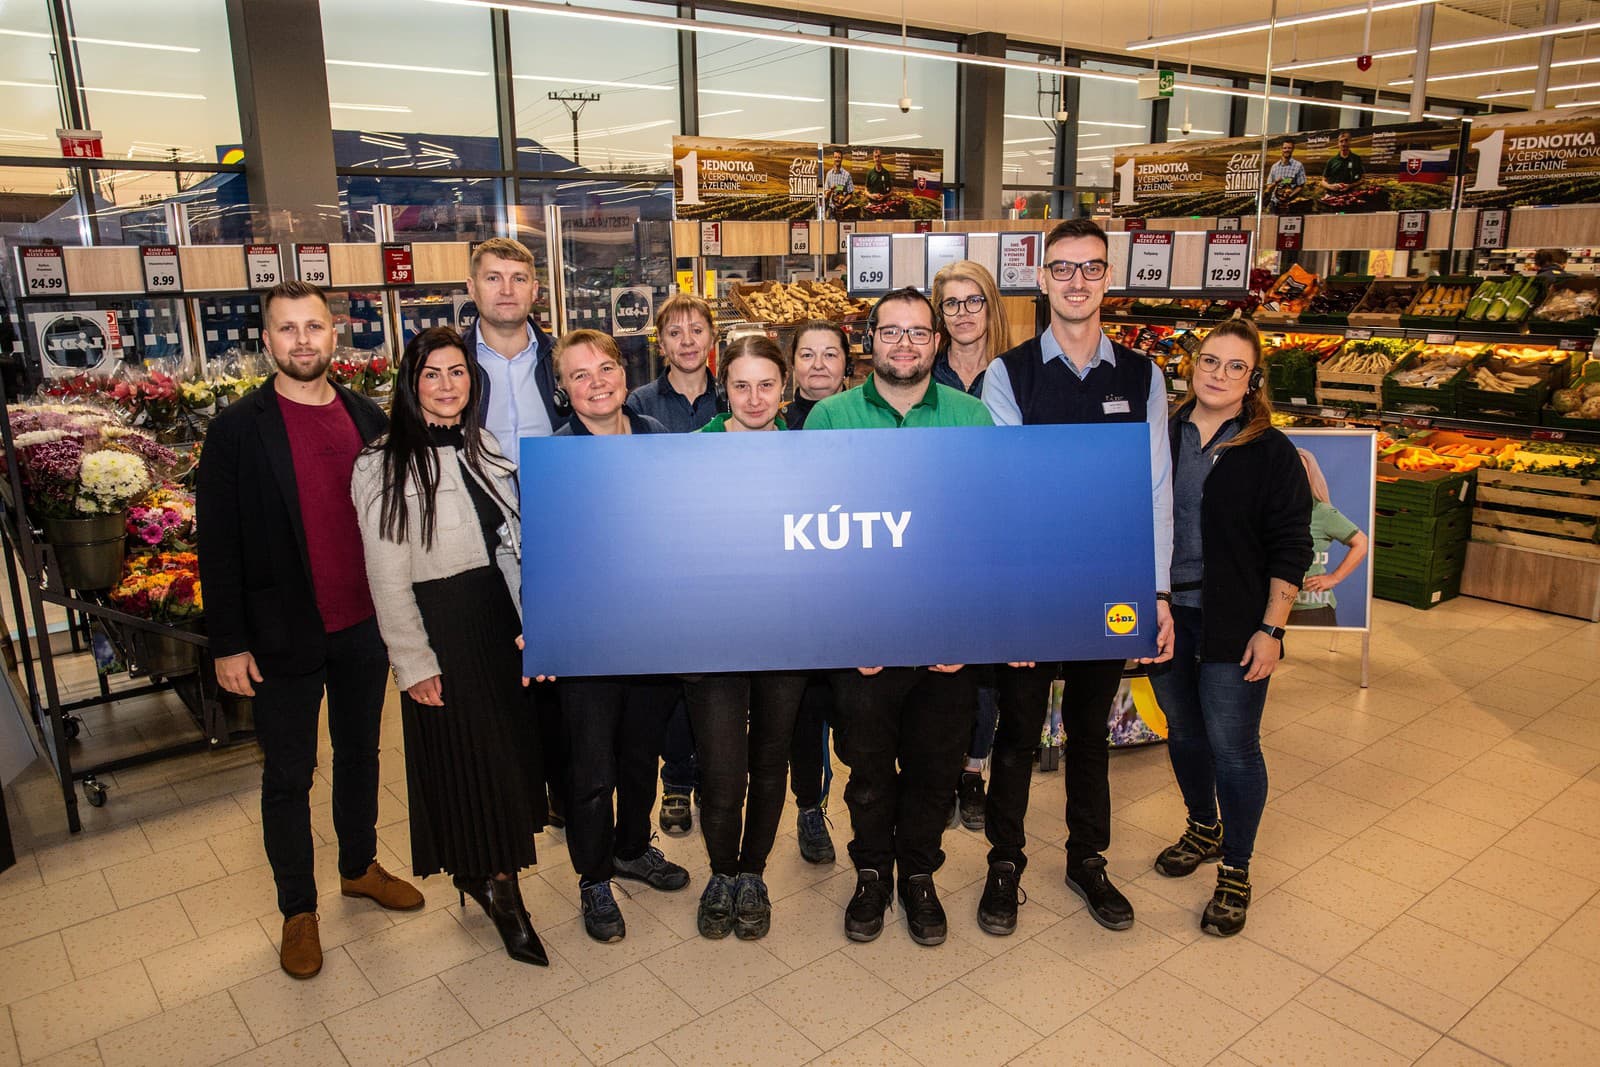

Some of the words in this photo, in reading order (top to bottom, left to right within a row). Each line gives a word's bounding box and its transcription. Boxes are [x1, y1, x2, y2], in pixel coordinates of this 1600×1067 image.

[1508, 132, 1596, 151] JEDNOTKA
[1508, 152, 1516, 162] V
[1517, 149, 1577, 162] ČERSTVOM
[701, 159, 755, 172] JEDNOTKA
[789, 157, 817, 176] Lidl
[1138, 162, 1189, 175] JEDNOTKA
[1226, 153, 1260, 173] Lidl
[1505, 162, 1514, 172] A
[1516, 160, 1568, 172] ZELENINE
[702, 173, 708, 181] V
[708, 171, 745, 182] ČERSTVOM
[746, 171, 768, 182] OVOCÍ
[1143, 173, 1179, 184] ČERSTVOM
[1179, 171, 1203, 182] OVOCÍ
[702, 182, 708, 190] A
[708, 181, 741, 190] ZELENINE
[1143, 182, 1174, 191] ZELENINE
[794, 242, 806, 250] 0.69
[152, 275, 174, 286] 8.99
[255, 273, 275, 283] 3.99
[305, 272, 325, 281] 3.99
[391, 270, 408, 280] 3.99
[859, 271, 884, 283] 6.99
[1136, 268, 1162, 281] 4.99
[1211, 268, 1241, 281] 12.99
[31, 278, 62, 289] 24.99
[783, 504, 912, 550] KÚTY
